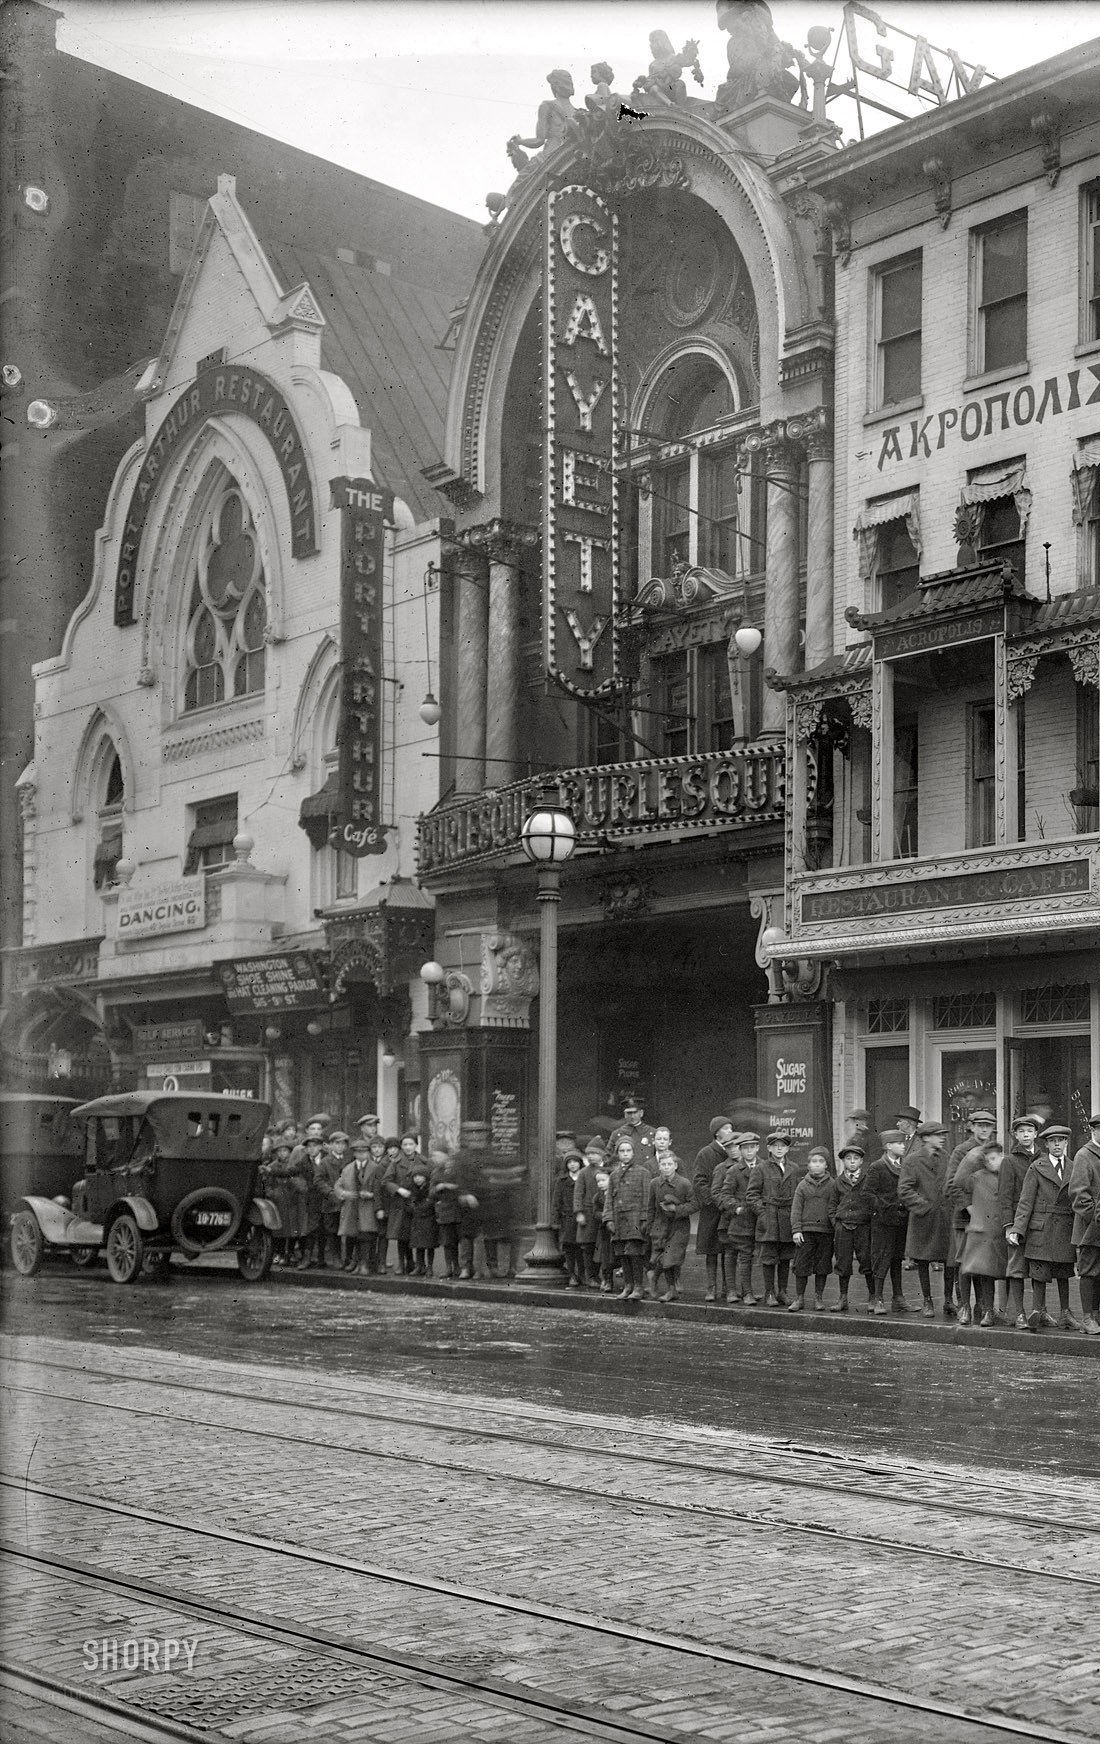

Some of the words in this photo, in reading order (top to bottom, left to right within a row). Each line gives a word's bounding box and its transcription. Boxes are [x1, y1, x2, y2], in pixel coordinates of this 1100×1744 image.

[560, 213, 613, 671] GAYETY
[117, 514, 139, 614] PORT
[138, 388, 201, 502] ARTHUR
[214, 373, 312, 541] RESTAURANT
[345, 487, 384, 512] THE
[354, 521, 377, 635] PORT
[896, 618, 983, 652] ACROPOLIS
[353, 654, 375, 822] ARTHUR
[343, 823, 378, 849] Café
[809, 880, 964, 918] RESTAURANT
[975, 879, 997, 899] &
[233, 958, 289, 974] WASHINGTON
[236, 971, 264, 986] SHOE
[265, 968, 296, 983] SHINE
[251, 981, 289, 997] CLEANING
[287, 978, 319, 992] PARLOR
[775, 1057, 807, 1080] SUGAR
[777, 1078, 807, 1097] PLUMS
[769, 1114, 797, 1127] HARRY
